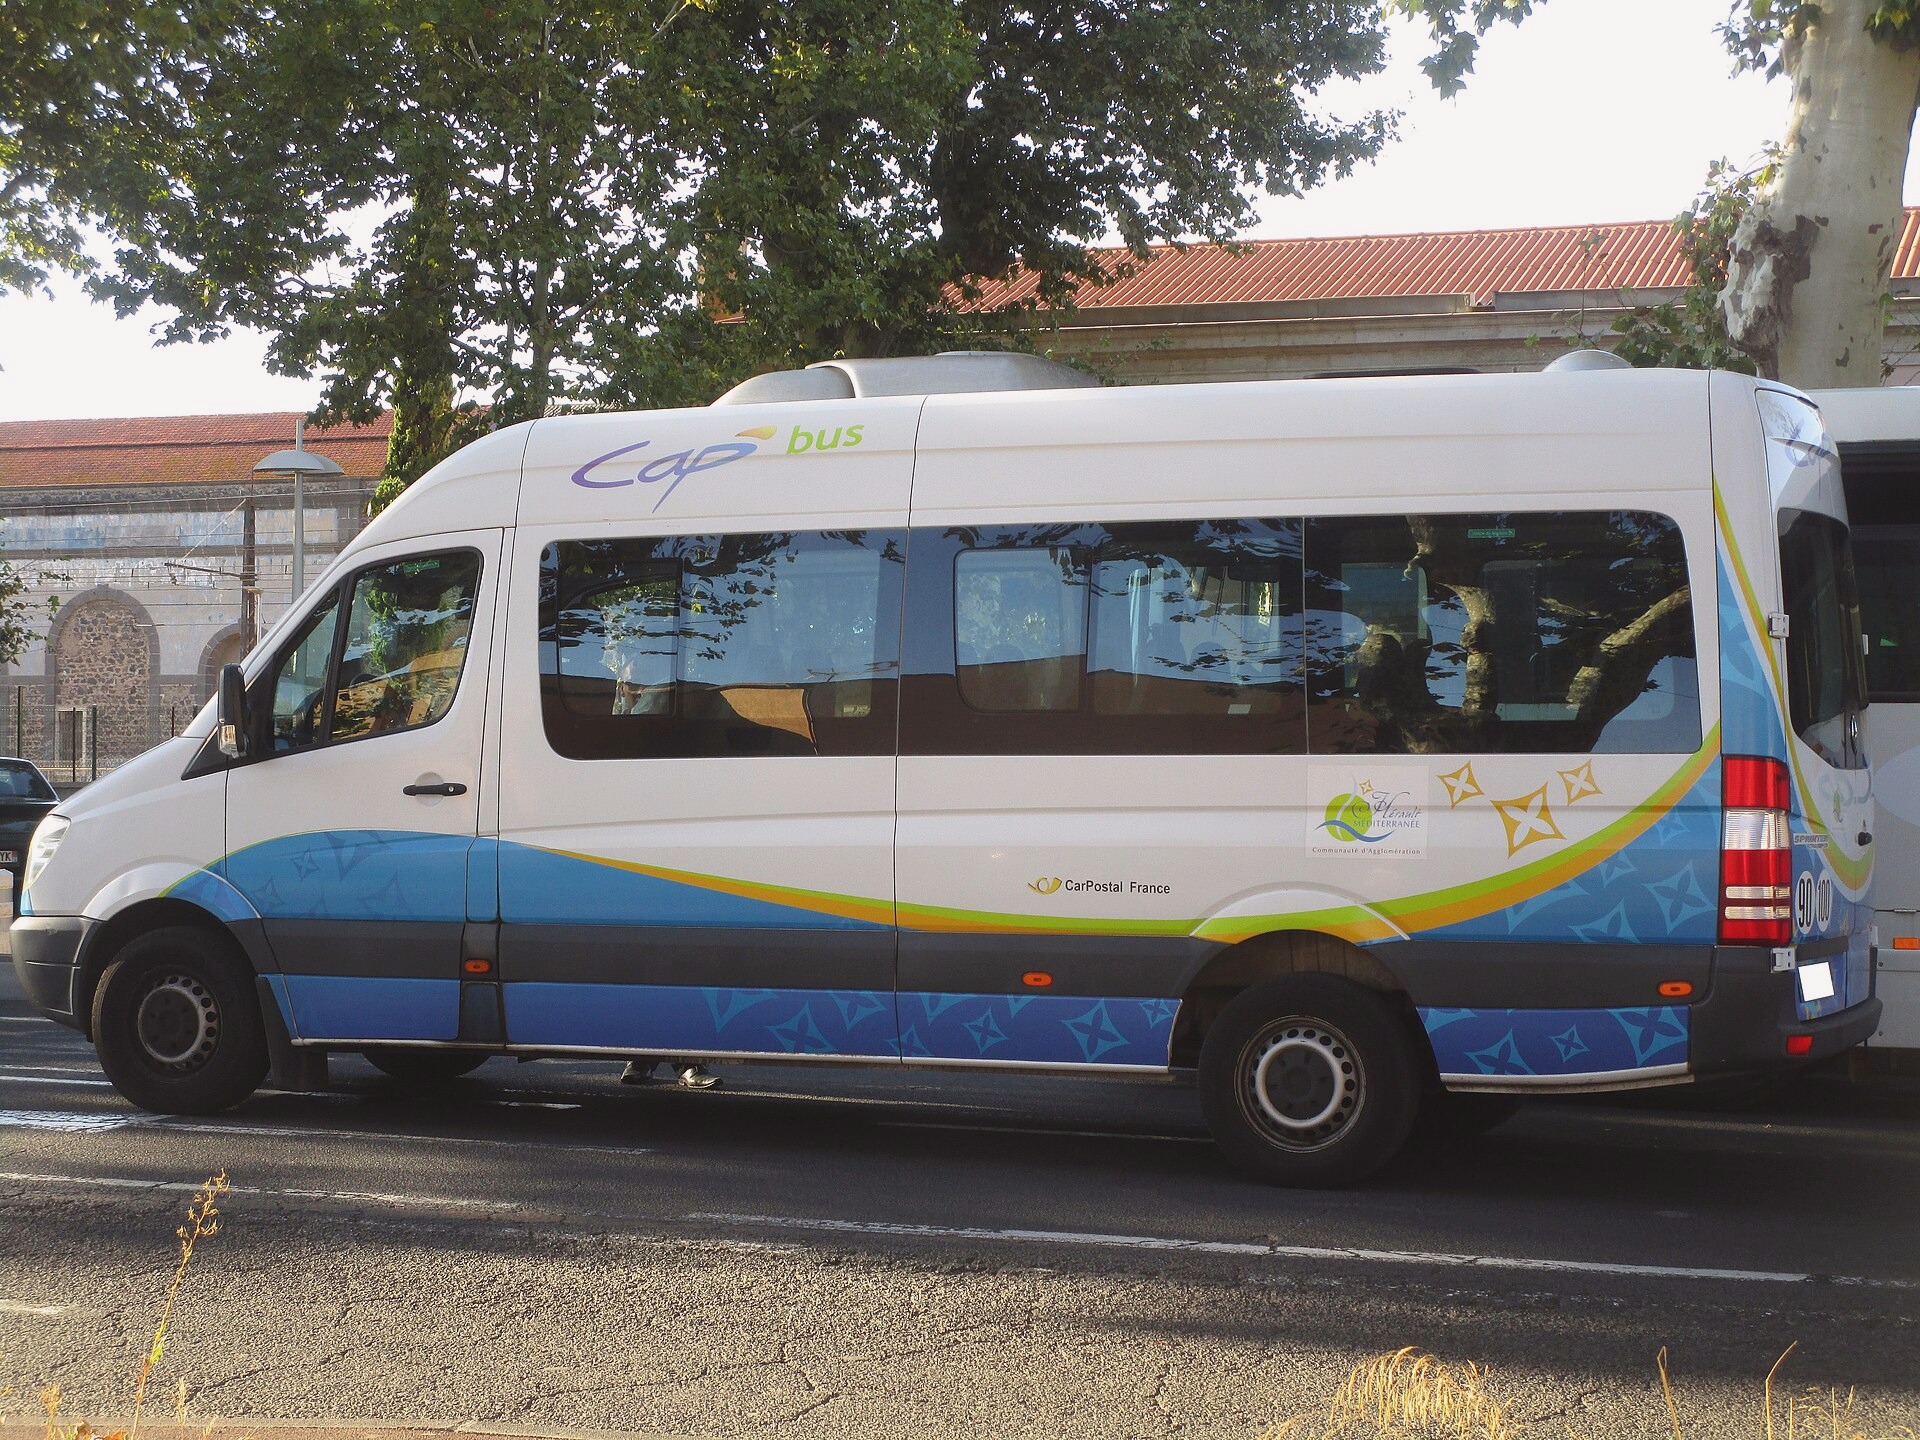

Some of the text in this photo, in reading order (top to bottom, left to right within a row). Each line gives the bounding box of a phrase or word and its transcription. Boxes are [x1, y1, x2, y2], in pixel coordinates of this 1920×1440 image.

[571, 424, 865, 514] Cap bus
[1361, 847, 1421, 856] d'Agglomération
[1065, 879, 1171, 894] CarPostal France
[1798, 877, 1812, 928] 90
[1817, 879, 1831, 922] 100
